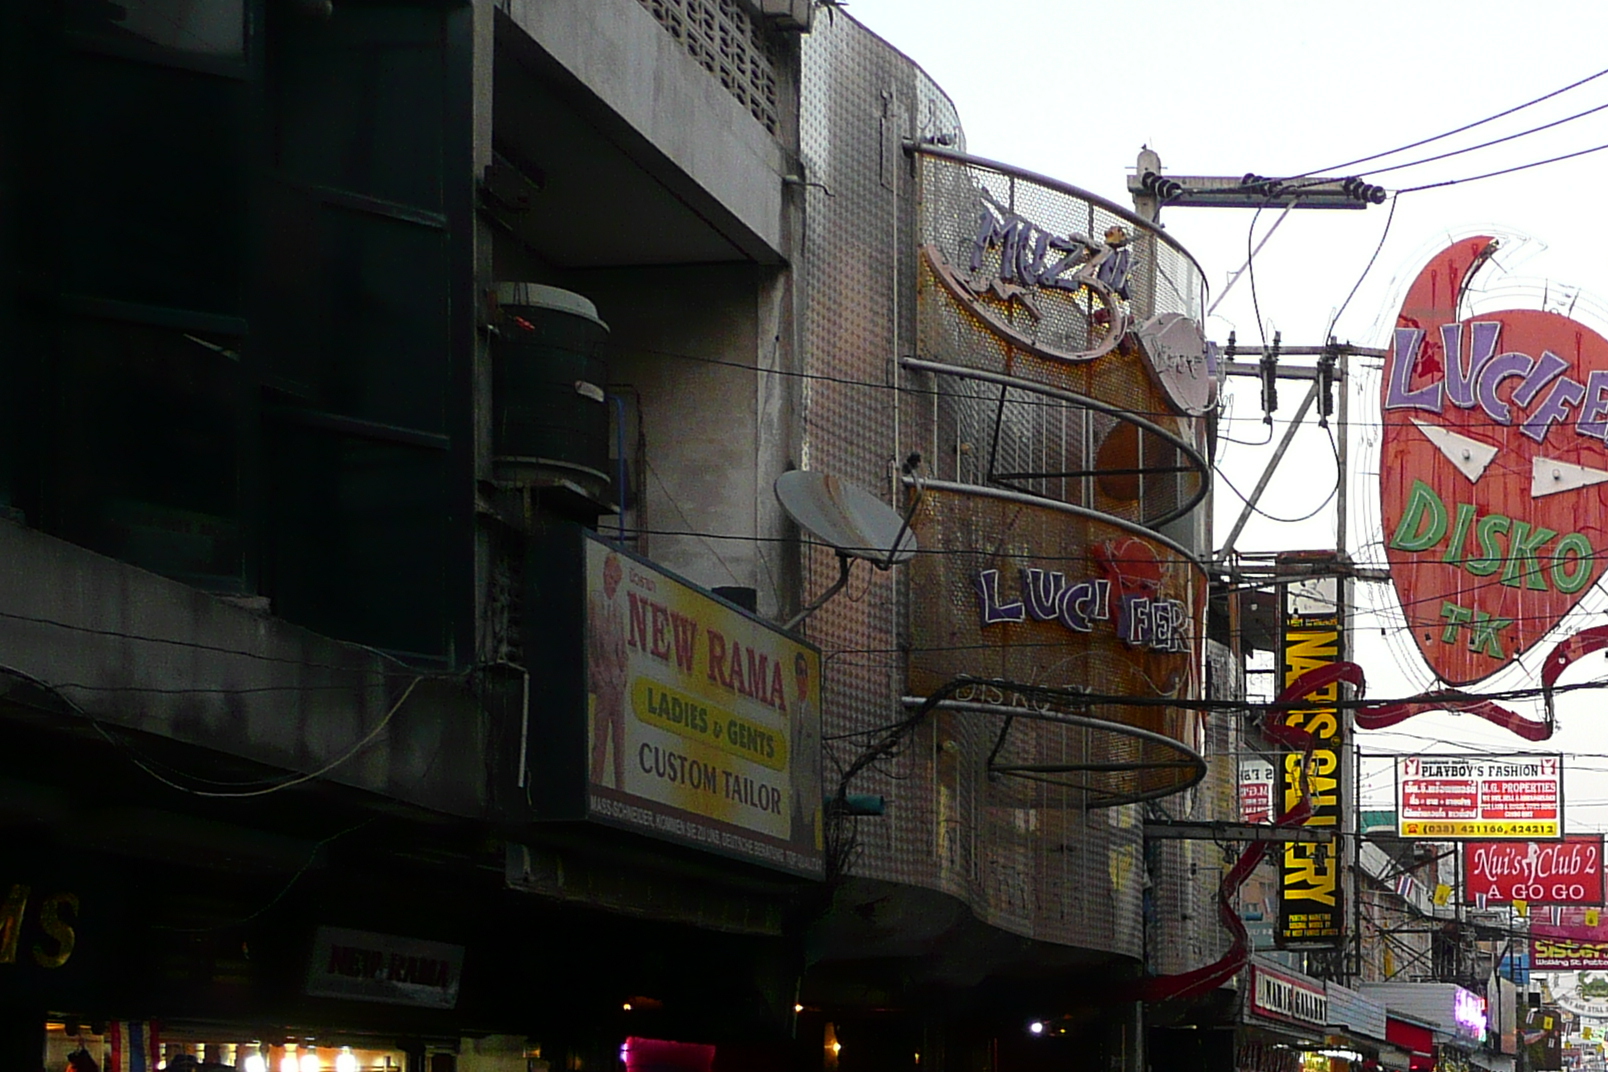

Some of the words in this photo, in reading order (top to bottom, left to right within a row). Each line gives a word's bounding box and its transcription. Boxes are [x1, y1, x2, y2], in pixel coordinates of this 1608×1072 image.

[1389, 479, 1593, 594] DISKO
[627, 591, 697, 676] NEW
[707, 628, 787, 712] RAMA
[1440, 601, 1515, 659] TK
[648, 686, 708, 734] LADIES
[714, 720, 723, 739] &
[728, 718, 774, 758] GENTS
[639, 742, 717, 794] CUSTOM
[723, 769, 782, 815] TAILOR
[1421, 764, 1484, 777] PLAYBOY'S
[1488, 764, 1539, 777] FASHION
[1502, 782, 1556, 793] PROPERTIES
[1473, 845, 1522, 881] Nui's
[1536, 845, 1581, 879] Club
[1584, 845, 1596, 874] 2
[1487, 884, 1503, 899] A
[1511, 884, 1544, 900] GO
[1552, 884, 1585, 900] GO
